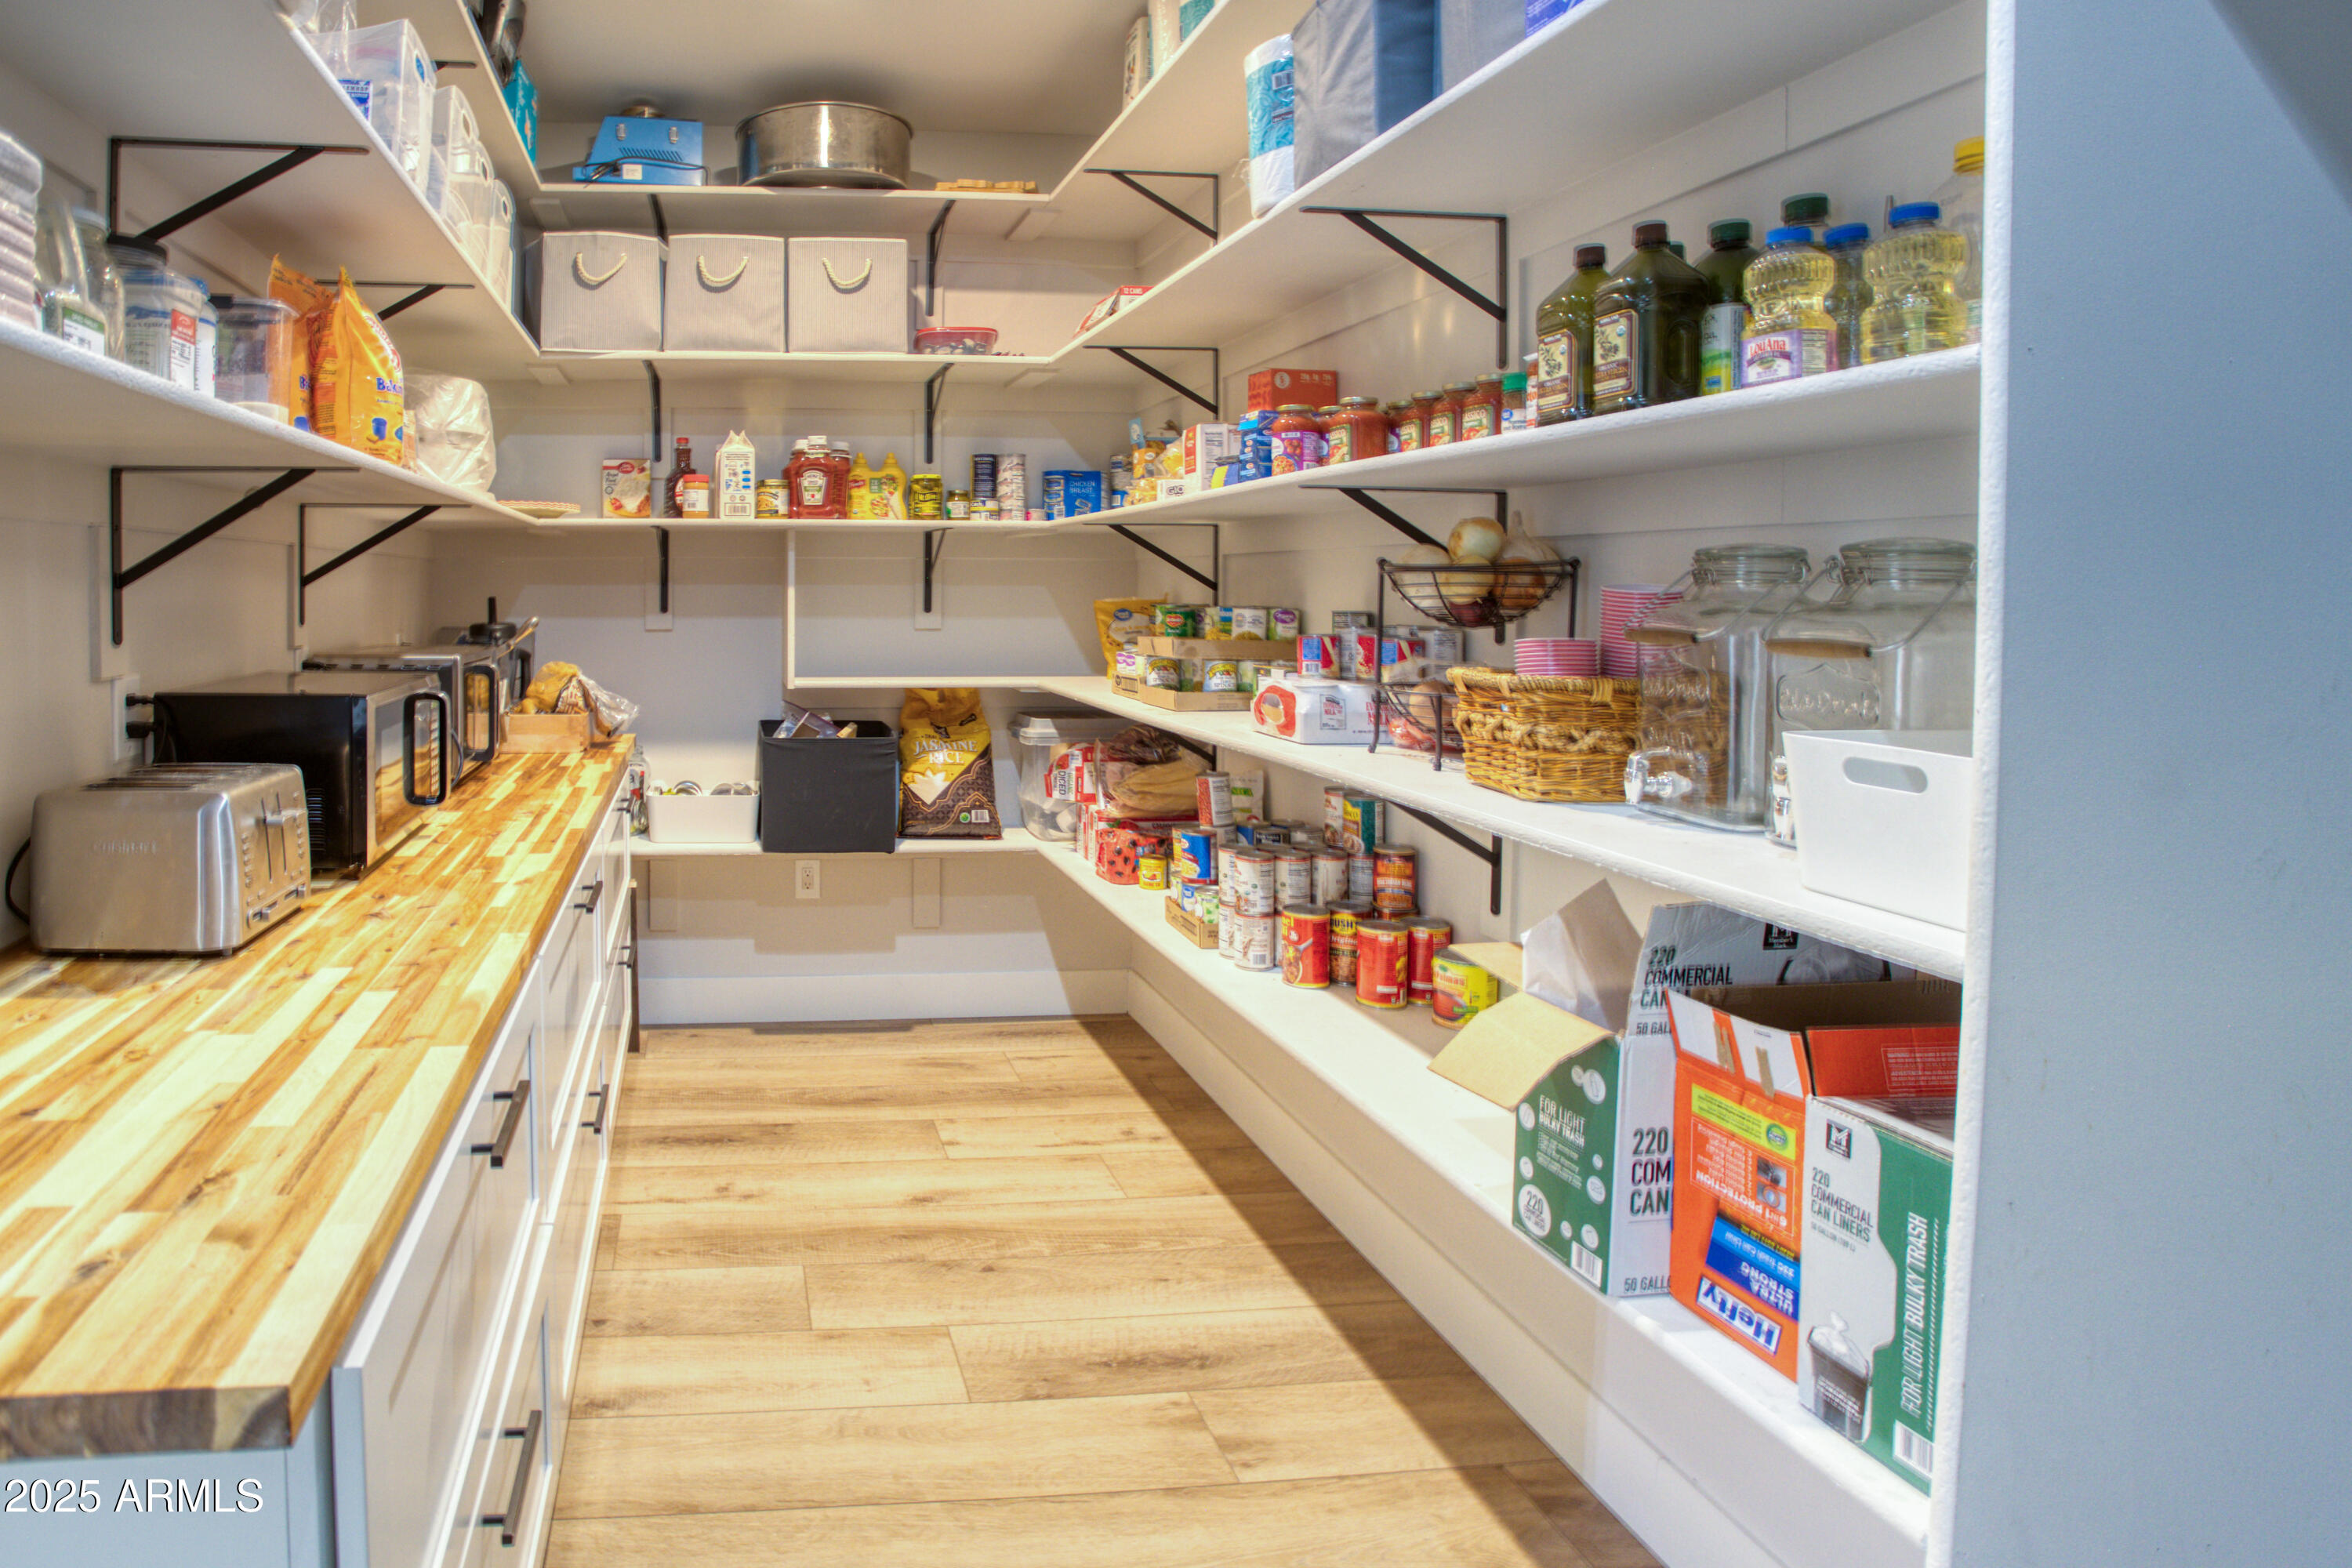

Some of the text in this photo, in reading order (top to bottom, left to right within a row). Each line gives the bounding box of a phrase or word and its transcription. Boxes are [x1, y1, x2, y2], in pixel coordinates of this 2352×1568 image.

[1750, 339, 1786, 358] LouAna
[914, 740, 978, 756] JASMINE
[929, 751, 964, 764] RICE
[1647, 946, 1675, 967] 220
[1644, 963, 1733, 987] COMMERCIAL
[1636, 1022, 1648, 1036] 50
[1540, 1094, 1586, 1133] FOR LIGHT
[1632, 1127, 1669, 1157] 220
[1696, 1170, 1763, 1214] PROTECTION
[1812, 1167, 1830, 1189] 220
[1526, 1190, 1544, 1215] 220
[1629, 1186, 1670, 1216] CAN
[1811, 1183, 1874, 1229] COMMERCIAL
[1811, 1199, 1870, 1243] CAN LINERS
[1624, 1277, 1637, 1293] 50
[1740, 1261, 1795, 1300] STRONG
[1748, 1277, 1794, 1317] ULTRA
[1702, 1283, 1776, 1348] Hefty
[1900, 1211, 1928, 1416] FOR LIGHT BULKY TRASH
